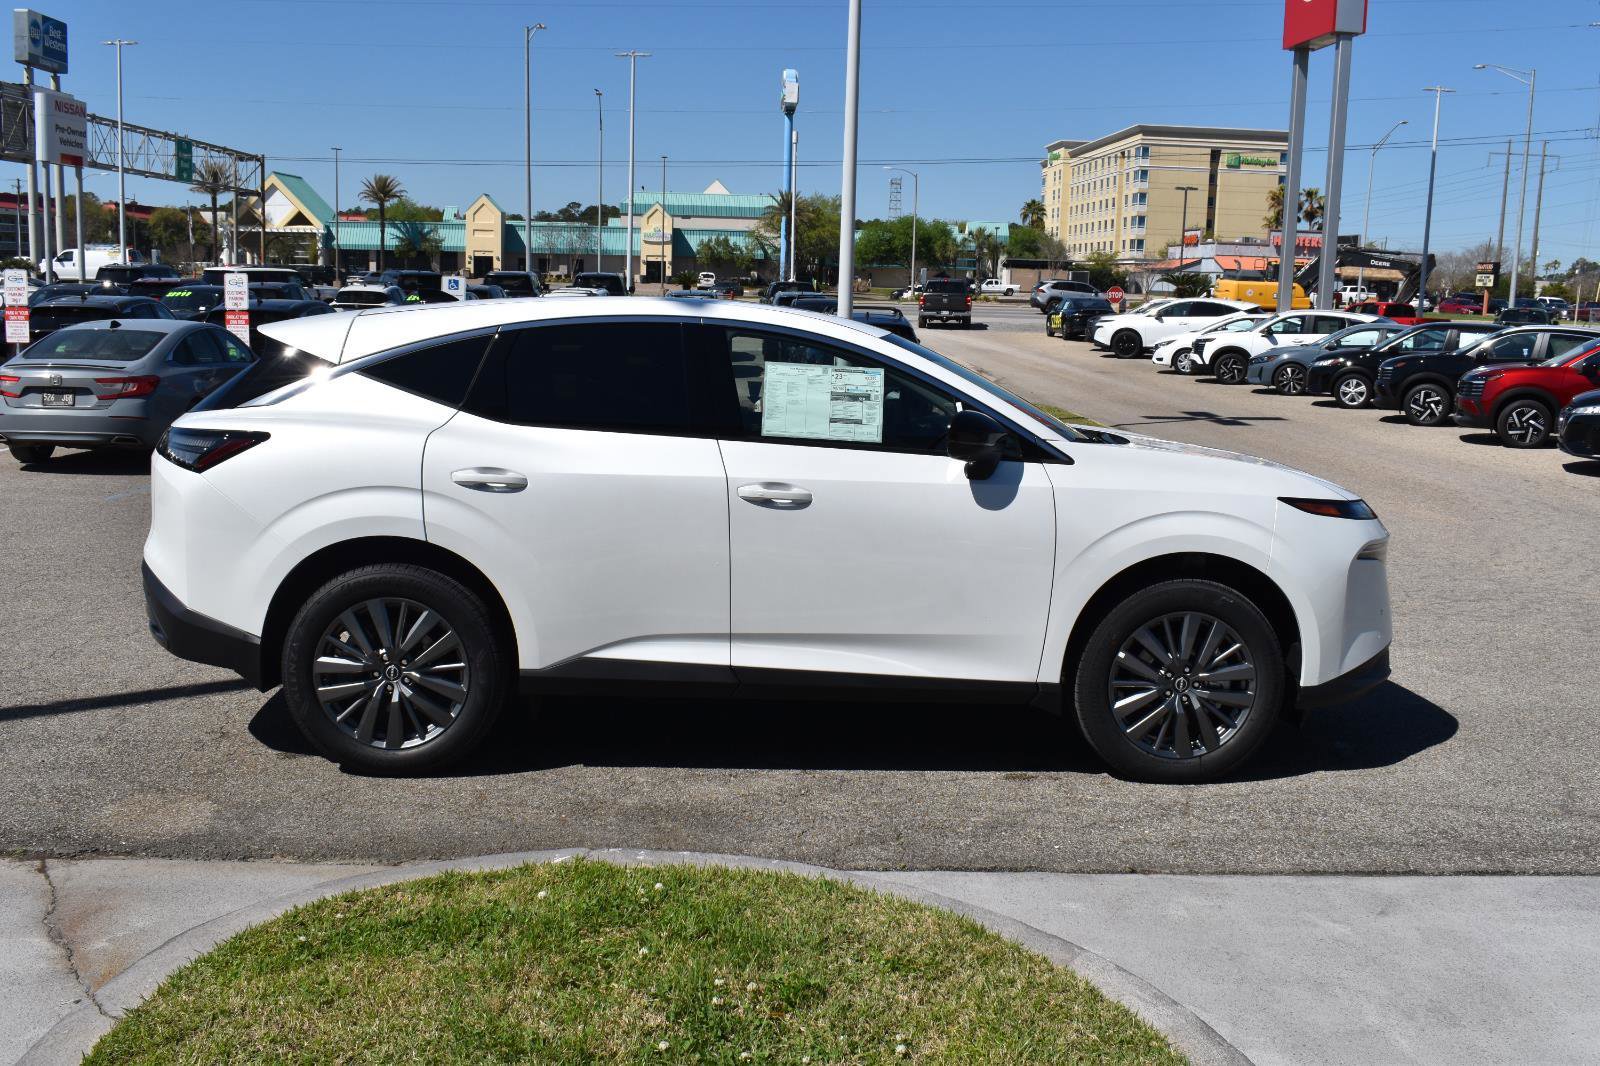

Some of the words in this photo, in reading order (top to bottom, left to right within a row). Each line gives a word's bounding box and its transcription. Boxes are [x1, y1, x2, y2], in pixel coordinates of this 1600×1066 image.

[49, 24, 62, 38] Best
[44, 38, 67, 53] Western
[54, 100, 86, 118] NISSAN
[55, 124, 86, 138] Pre-Owned
[59, 136, 84, 149] Vehicles
[1241, 156, 1266, 167] Holiday
[1370, 259, 1390, 267] DEERE
[1109, 291, 1123, 299] STOP
[43, 393, 55, 401] 526
